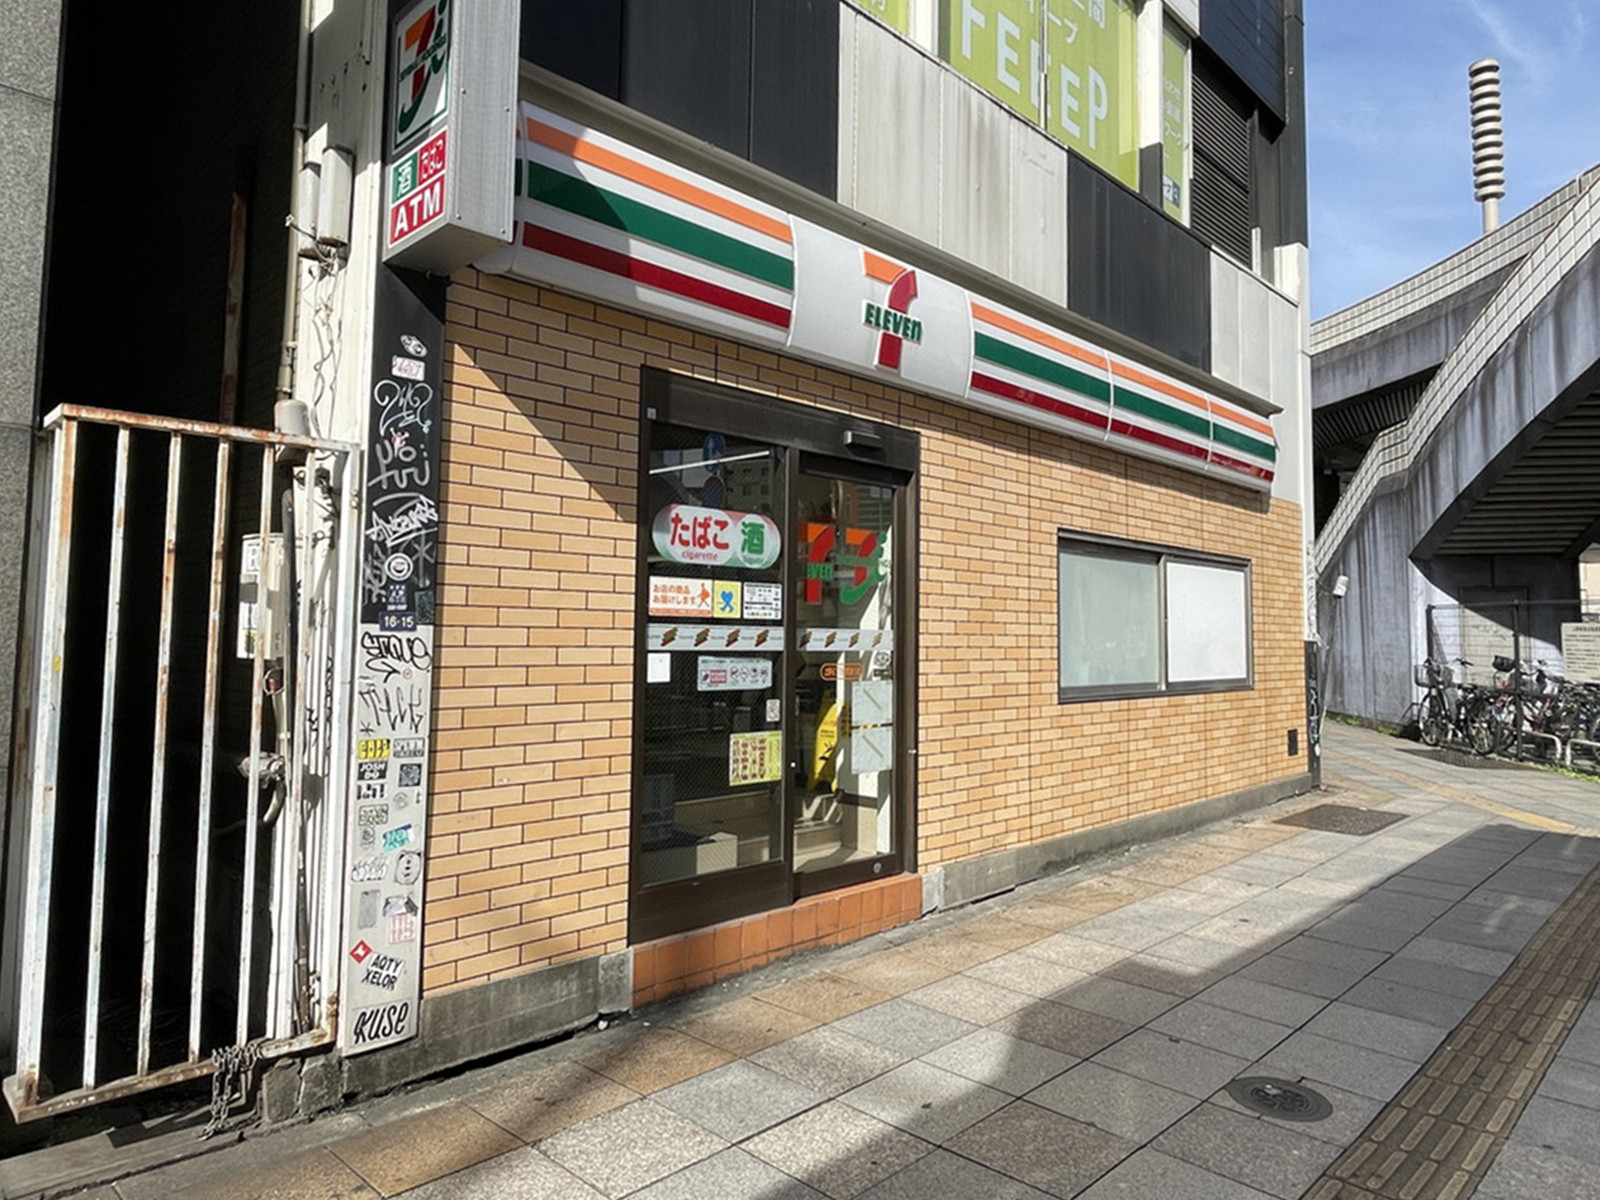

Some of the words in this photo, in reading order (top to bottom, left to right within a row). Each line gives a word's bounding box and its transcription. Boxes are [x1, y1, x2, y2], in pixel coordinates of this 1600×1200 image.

[394, 181, 441, 238] ATM
[671, 512, 730, 550] たばこ
[741, 521, 765, 555] 酒
[384, 615, 414, 628] 16-15
[371, 954, 402, 973] AQTY
[361, 968, 398, 991] XELOR
